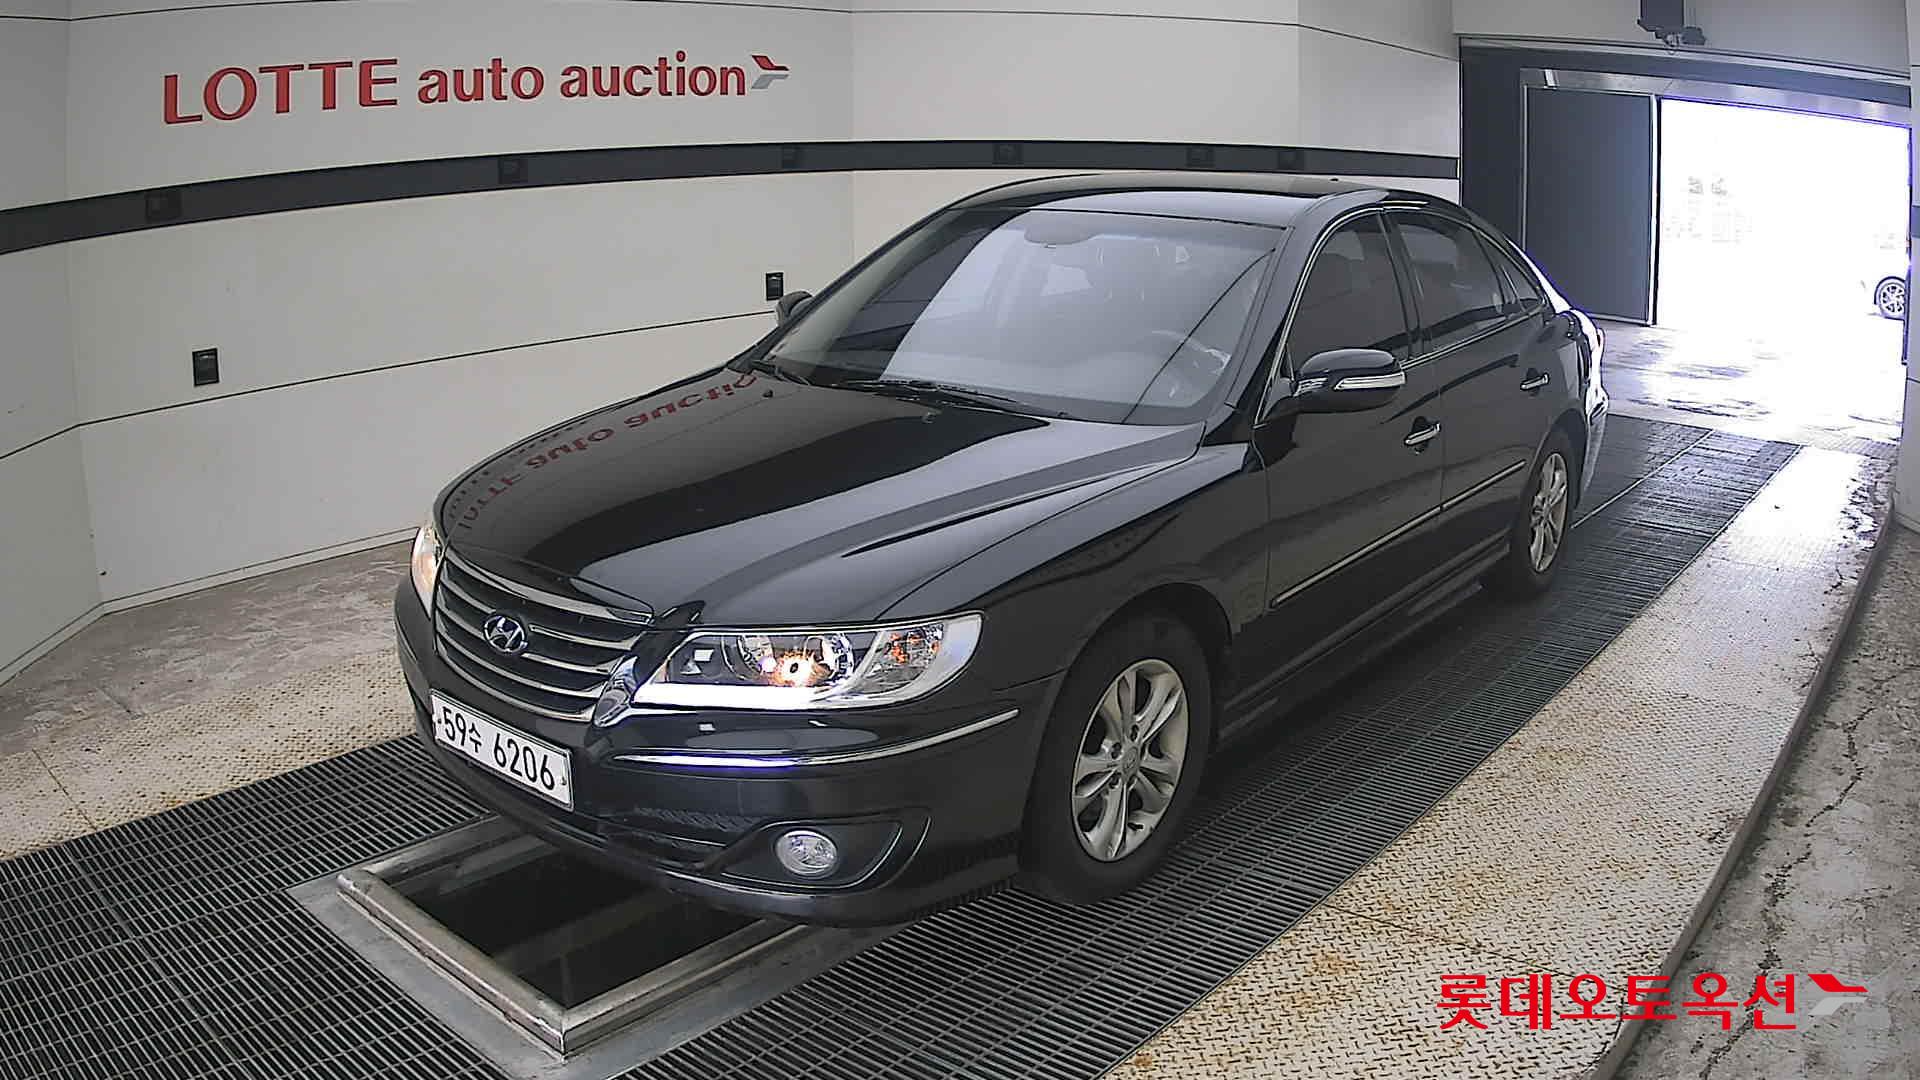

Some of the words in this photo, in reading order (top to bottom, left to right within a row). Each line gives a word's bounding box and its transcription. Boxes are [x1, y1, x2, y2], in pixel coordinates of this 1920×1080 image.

[163, 58, 399, 125] LOTTE
[417, 57, 545, 104] auto
[560, 50, 746, 97] auction
[442, 706, 483, 753] 59수
[493, 732, 556, 791] 6206
